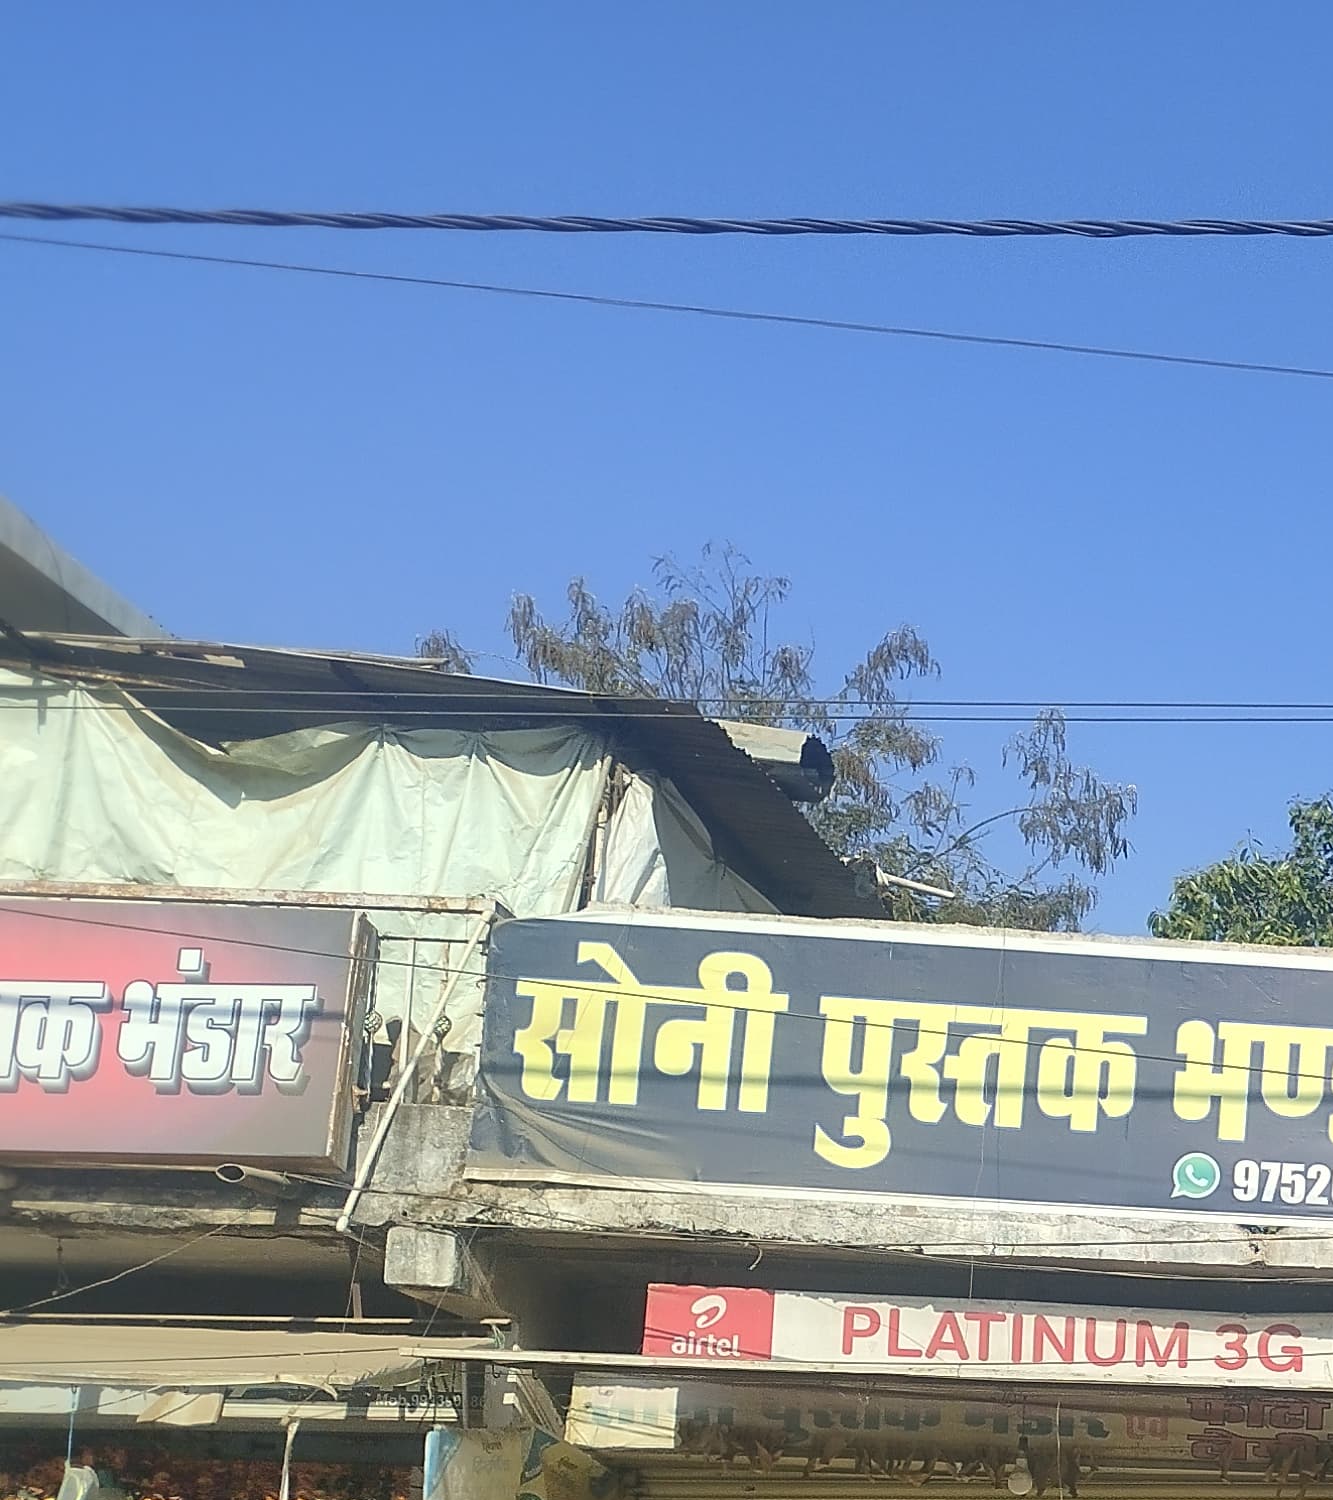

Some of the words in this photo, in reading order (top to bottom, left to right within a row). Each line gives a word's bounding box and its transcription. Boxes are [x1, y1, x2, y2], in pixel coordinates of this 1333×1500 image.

[117, 948, 318, 1086] भंडार
[515, 941, 789, 1113] सोनी
[814, 995, 1148, 1169] पुस्तक
[670, 1330, 742, 1358] airtel
[842, 1306, 1188, 1370] PLATINUM
[1214, 1324, 1305, 1373] 3G
